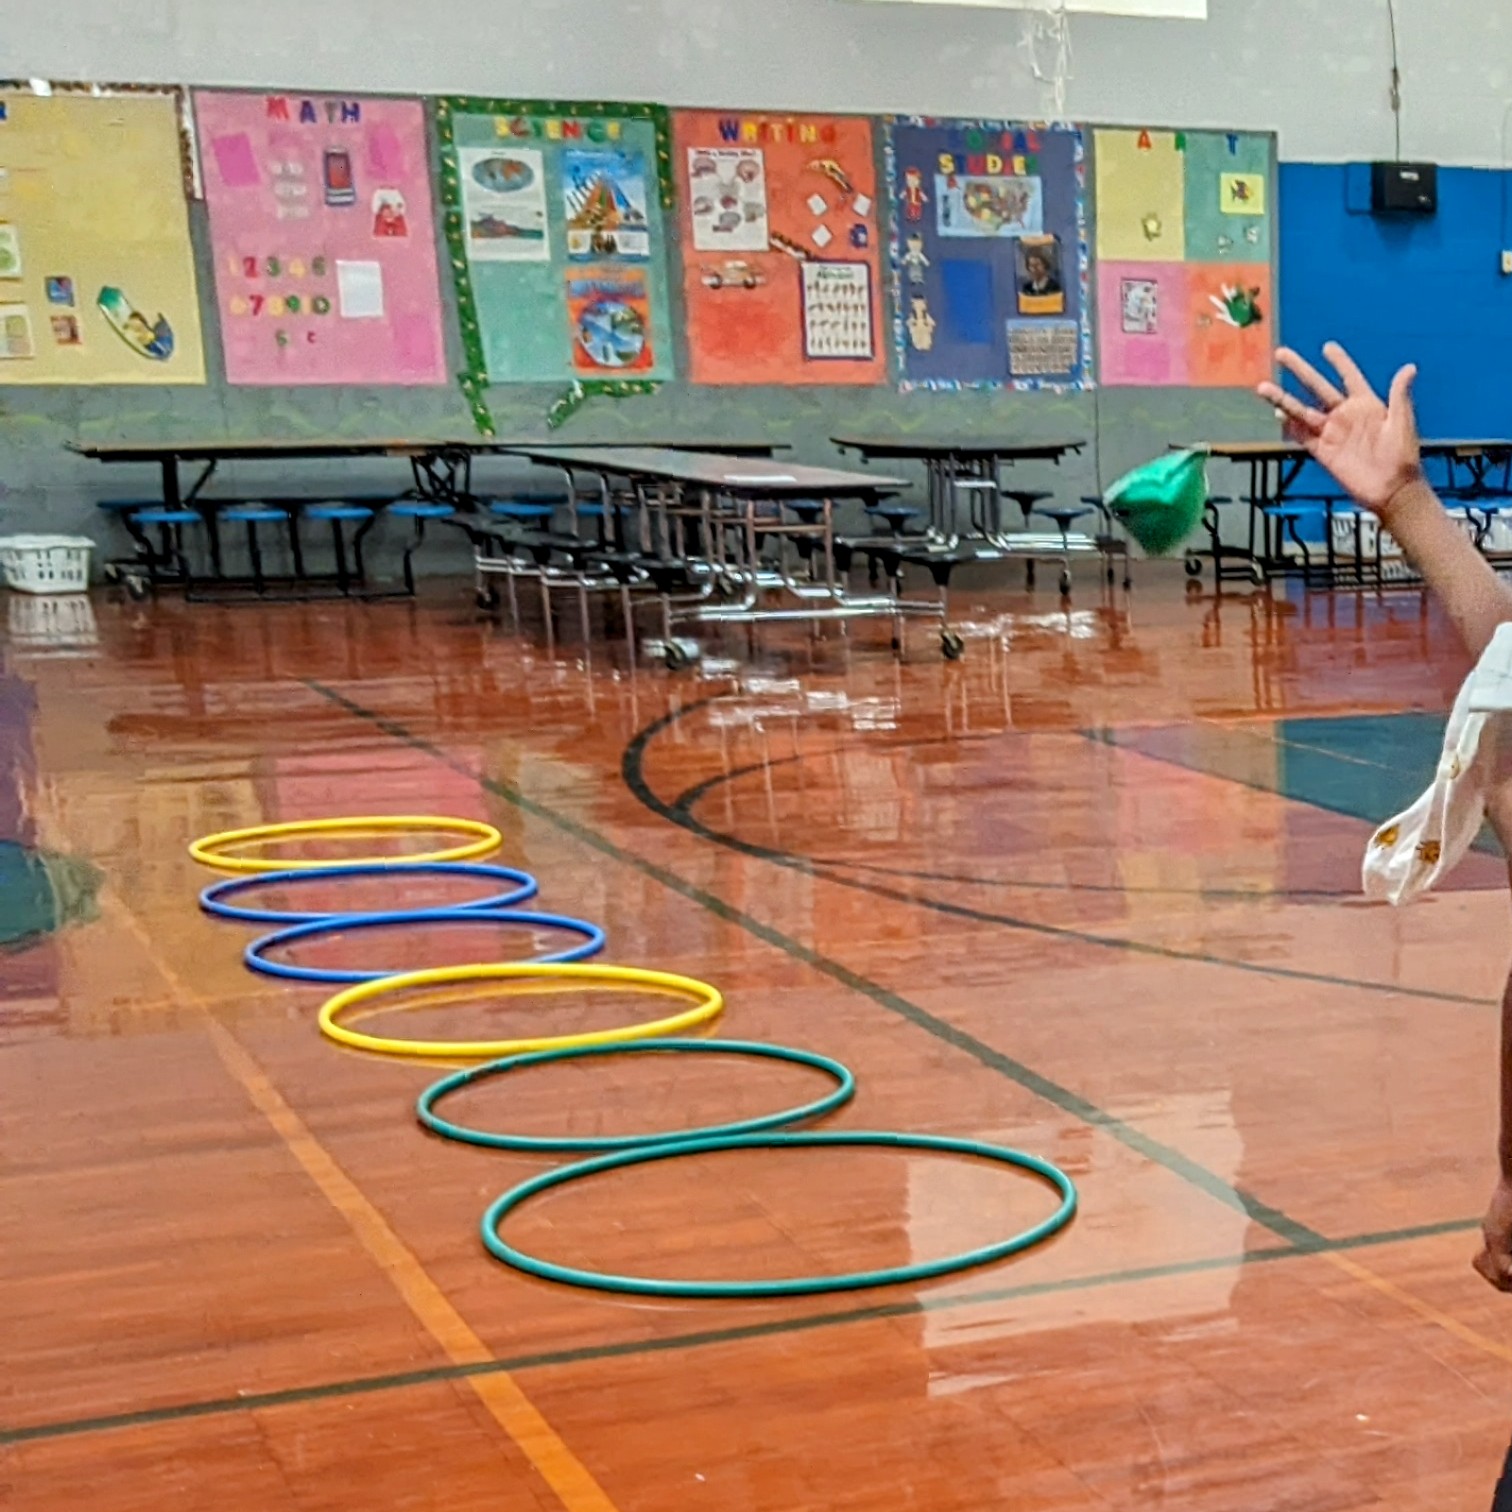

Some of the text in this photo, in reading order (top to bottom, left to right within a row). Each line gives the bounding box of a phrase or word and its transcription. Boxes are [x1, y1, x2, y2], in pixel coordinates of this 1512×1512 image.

[266, 97, 360, 123] MATH
[494, 116, 621, 142] SCIENCE
[719, 118, 836, 143] WRITING
[1137, 129, 1239, 156] ART
[938, 153, 1039, 176] STUDIES
[243, 256, 258, 278] 2
[249, 294, 264, 316] 7
